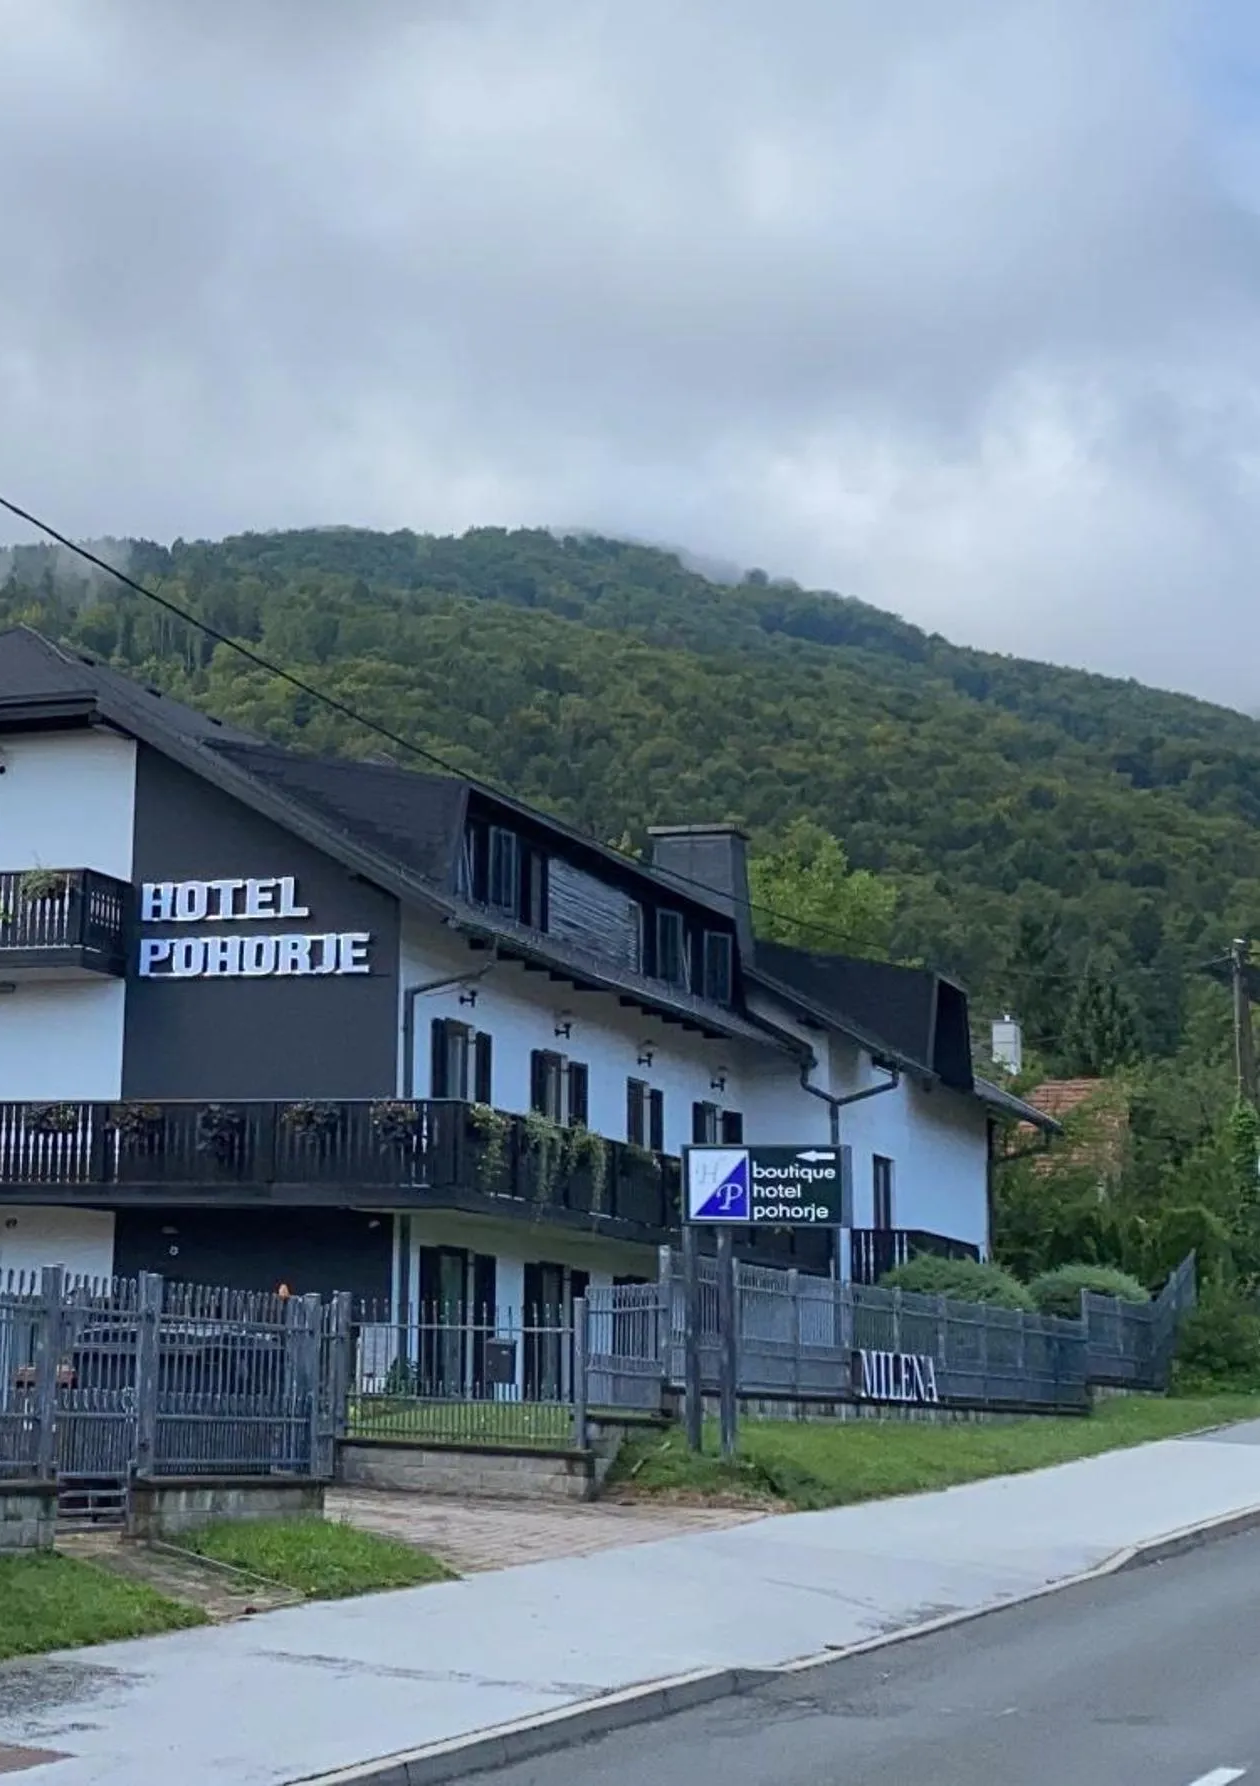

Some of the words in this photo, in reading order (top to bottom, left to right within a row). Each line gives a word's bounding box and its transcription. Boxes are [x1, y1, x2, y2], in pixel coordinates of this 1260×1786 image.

[141, 876, 309, 922] HOTEL
[139, 932, 370, 977] POHORJE
[752, 1161, 836, 1183] boutique
[716, 1183, 744, 1211] P
[753, 1184, 802, 1199] hotel
[753, 1203, 830, 1222] pohorje
[859, 1348, 940, 1402] MILENA
